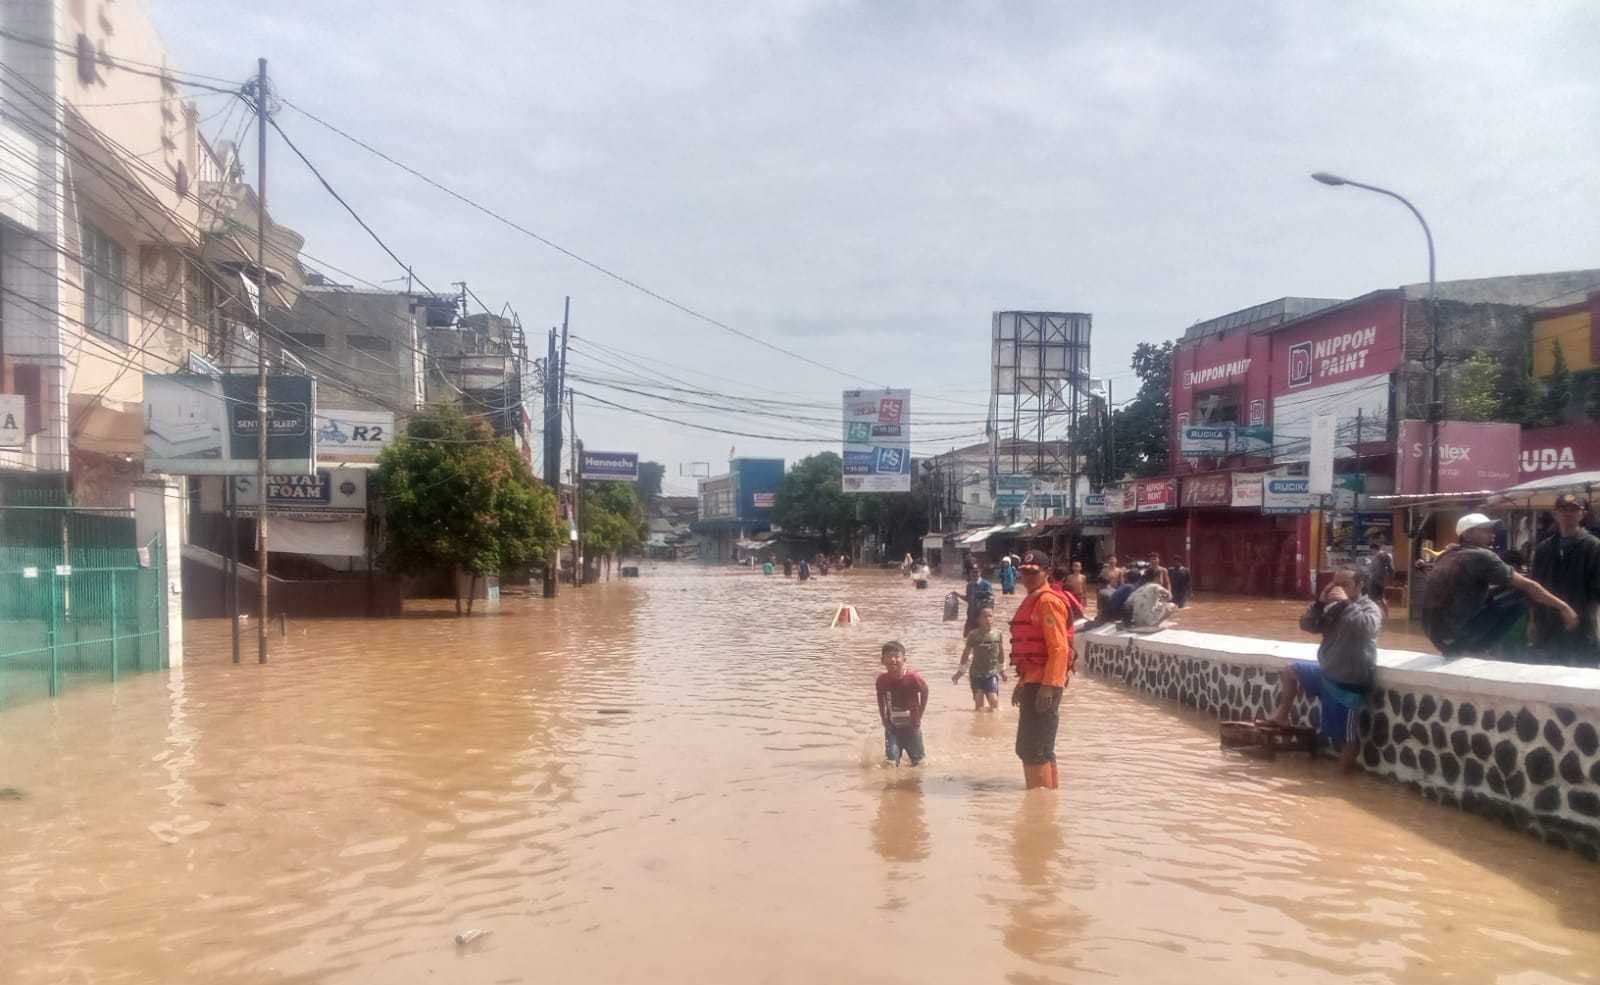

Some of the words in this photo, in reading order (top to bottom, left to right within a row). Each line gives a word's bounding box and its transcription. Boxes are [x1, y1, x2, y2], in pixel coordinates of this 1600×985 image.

[1315, 326, 1377, 359] NIPPON
[1190, 363, 1226, 385] NIPPON
[1320, 349, 1369, 377] PAINT
[352, 424, 383, 441] R2
[1518, 446, 1576, 473] UDA
[269, 485, 321, 498] FOAM
